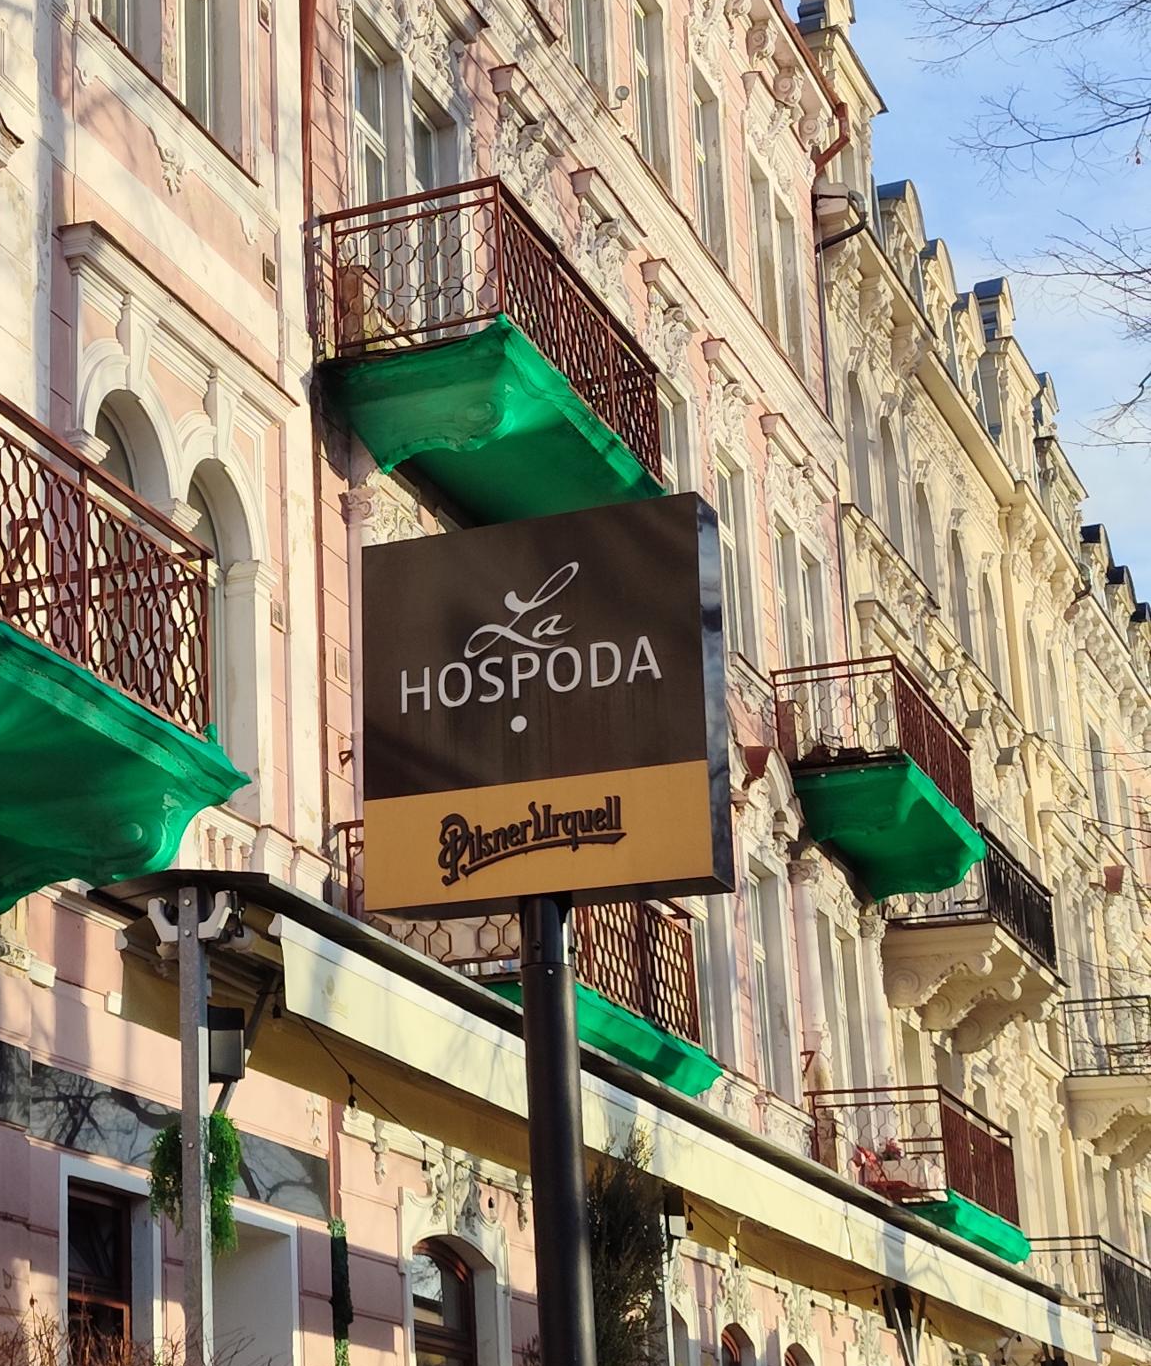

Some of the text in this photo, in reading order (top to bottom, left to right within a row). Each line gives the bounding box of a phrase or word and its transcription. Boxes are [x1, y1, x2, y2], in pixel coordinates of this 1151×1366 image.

[463, 561, 579, 658] La
[400, 635, 663, 715] HOSPODA
[438, 795, 622, 887] Pilsner Urquell
